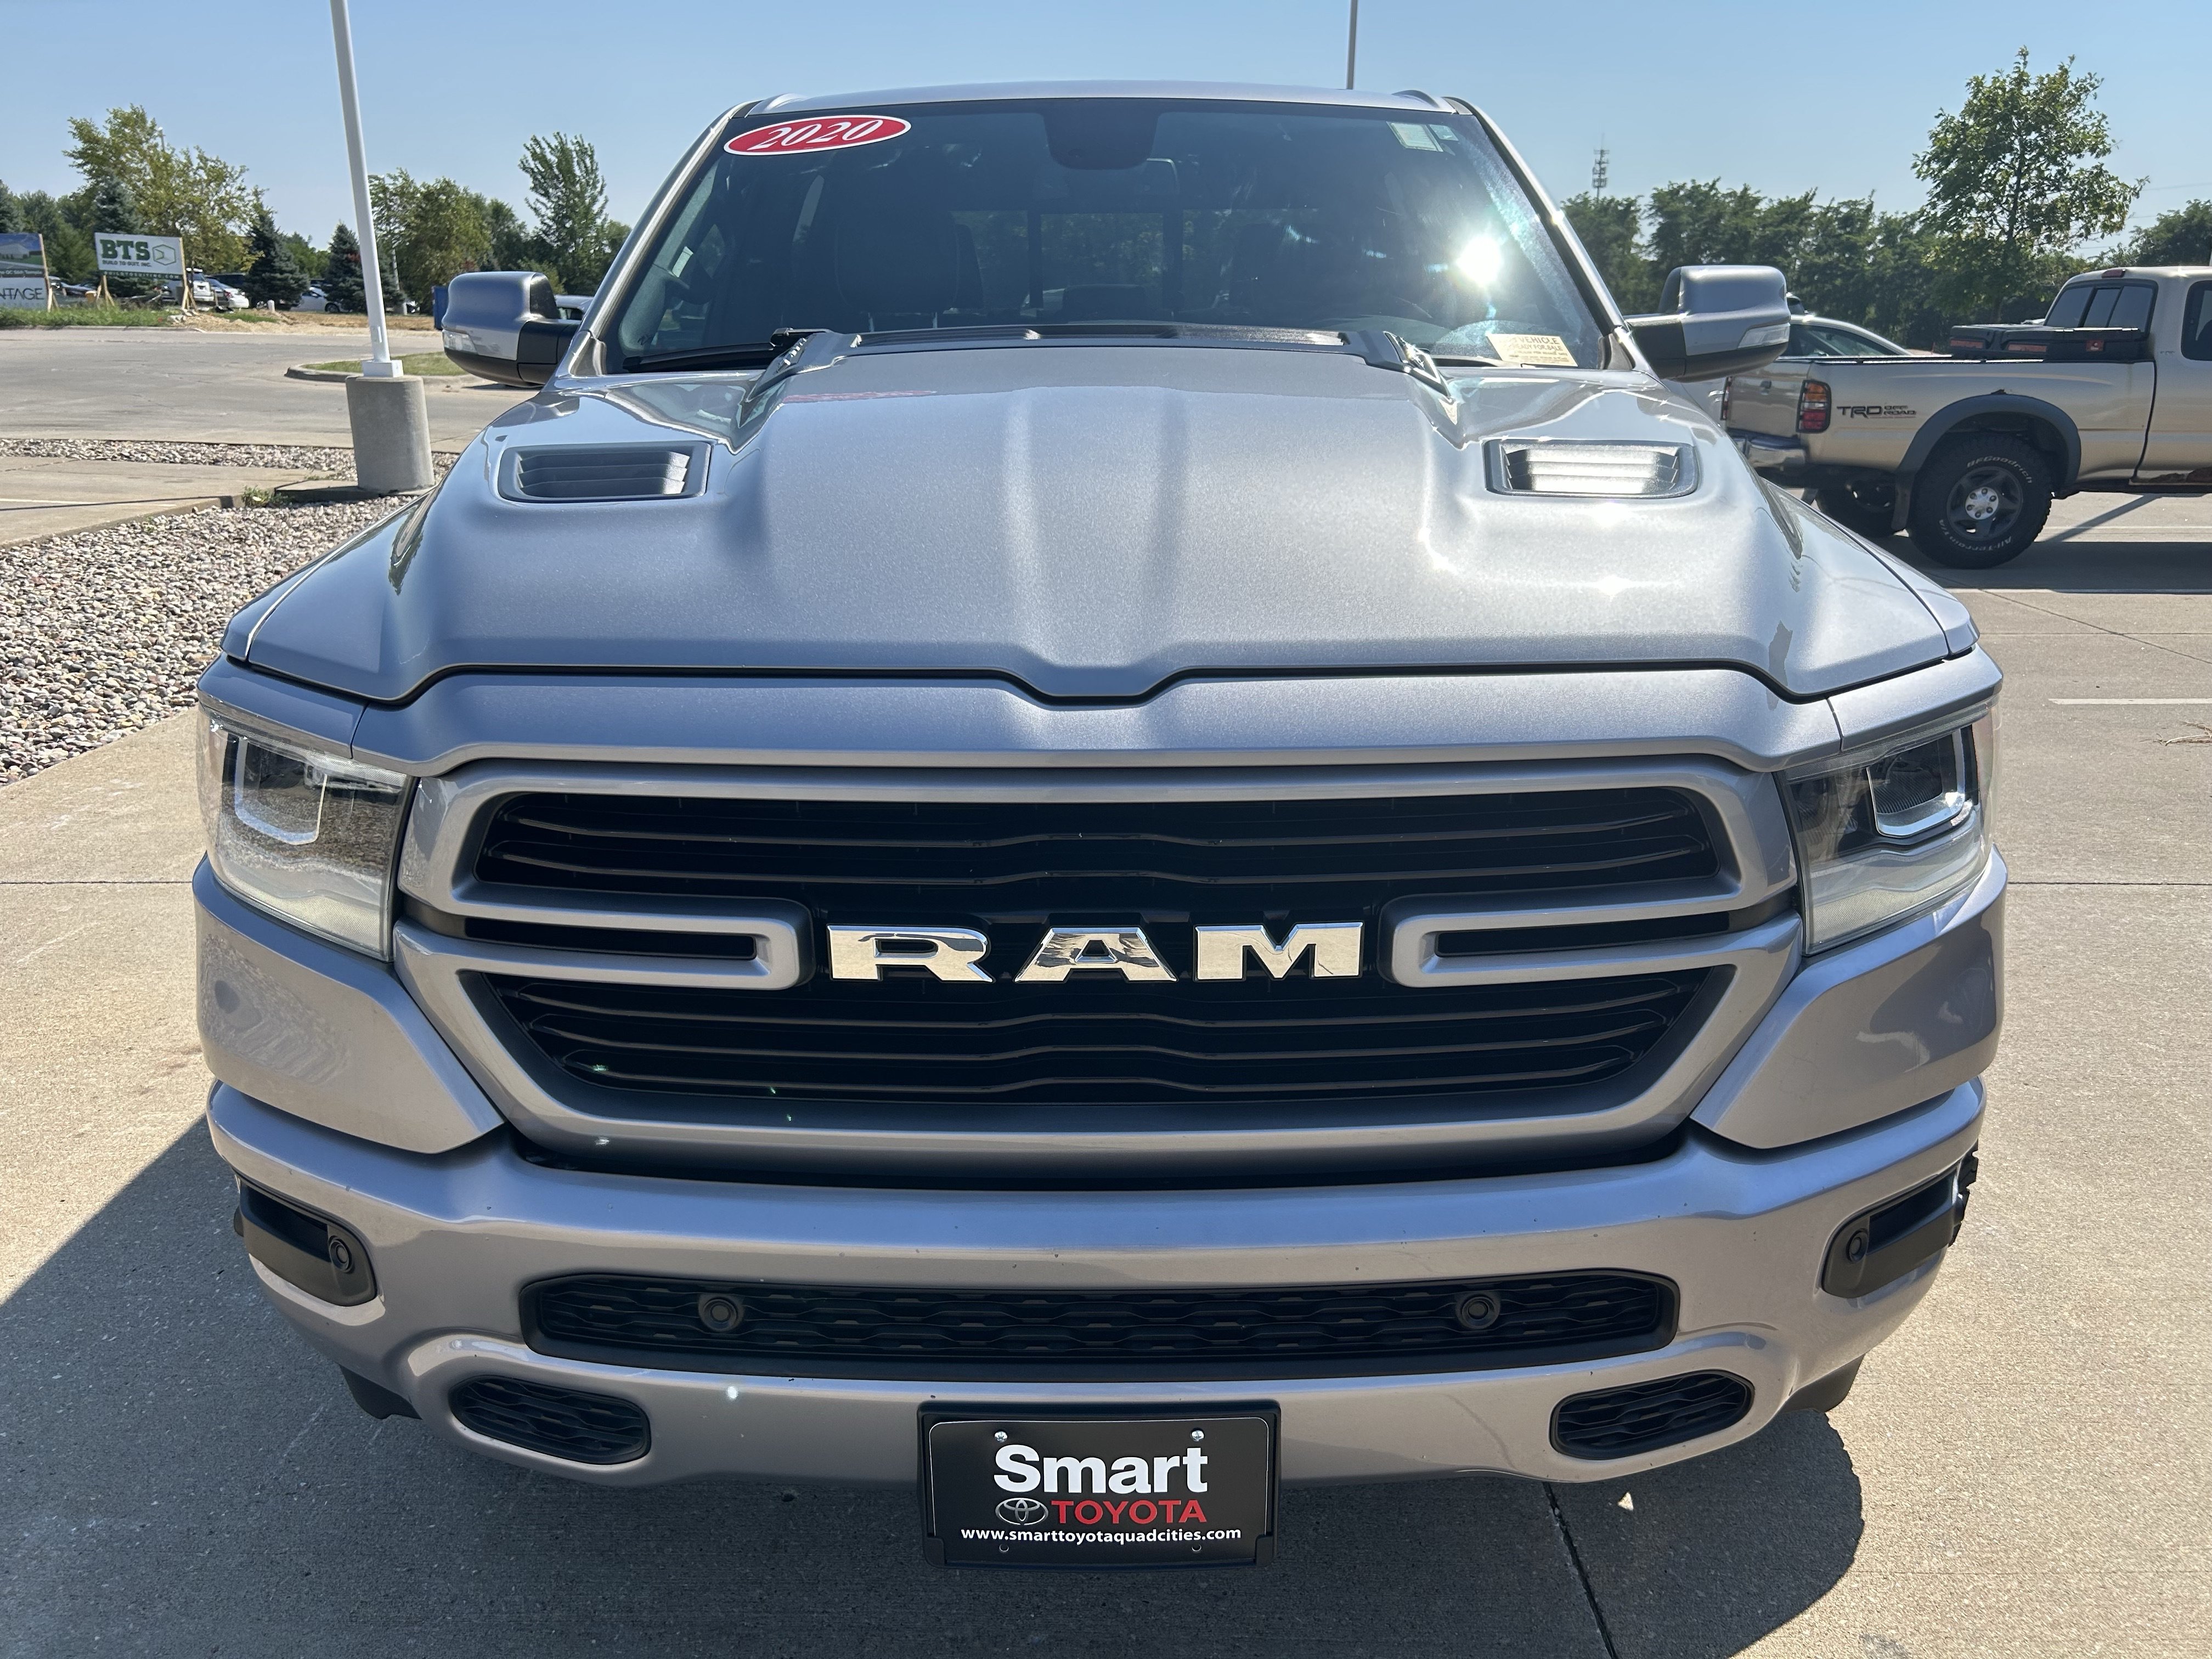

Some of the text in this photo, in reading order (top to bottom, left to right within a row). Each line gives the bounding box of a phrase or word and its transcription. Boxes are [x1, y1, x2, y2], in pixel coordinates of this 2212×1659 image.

[747, 119, 883, 151] 2020
[99, 239, 150, 261] BTS
[1517, 336, 1560, 345] VEHICLE
[1837, 405, 1882, 419] TRD
[826, 922, 1364, 984] RAM
[993, 1444, 1208, 1494] Smart
[1051, 1499, 1207, 1525] TOYOTA
[961, 1527, 1242, 1548] www.smarttoyotaquadcities.com
